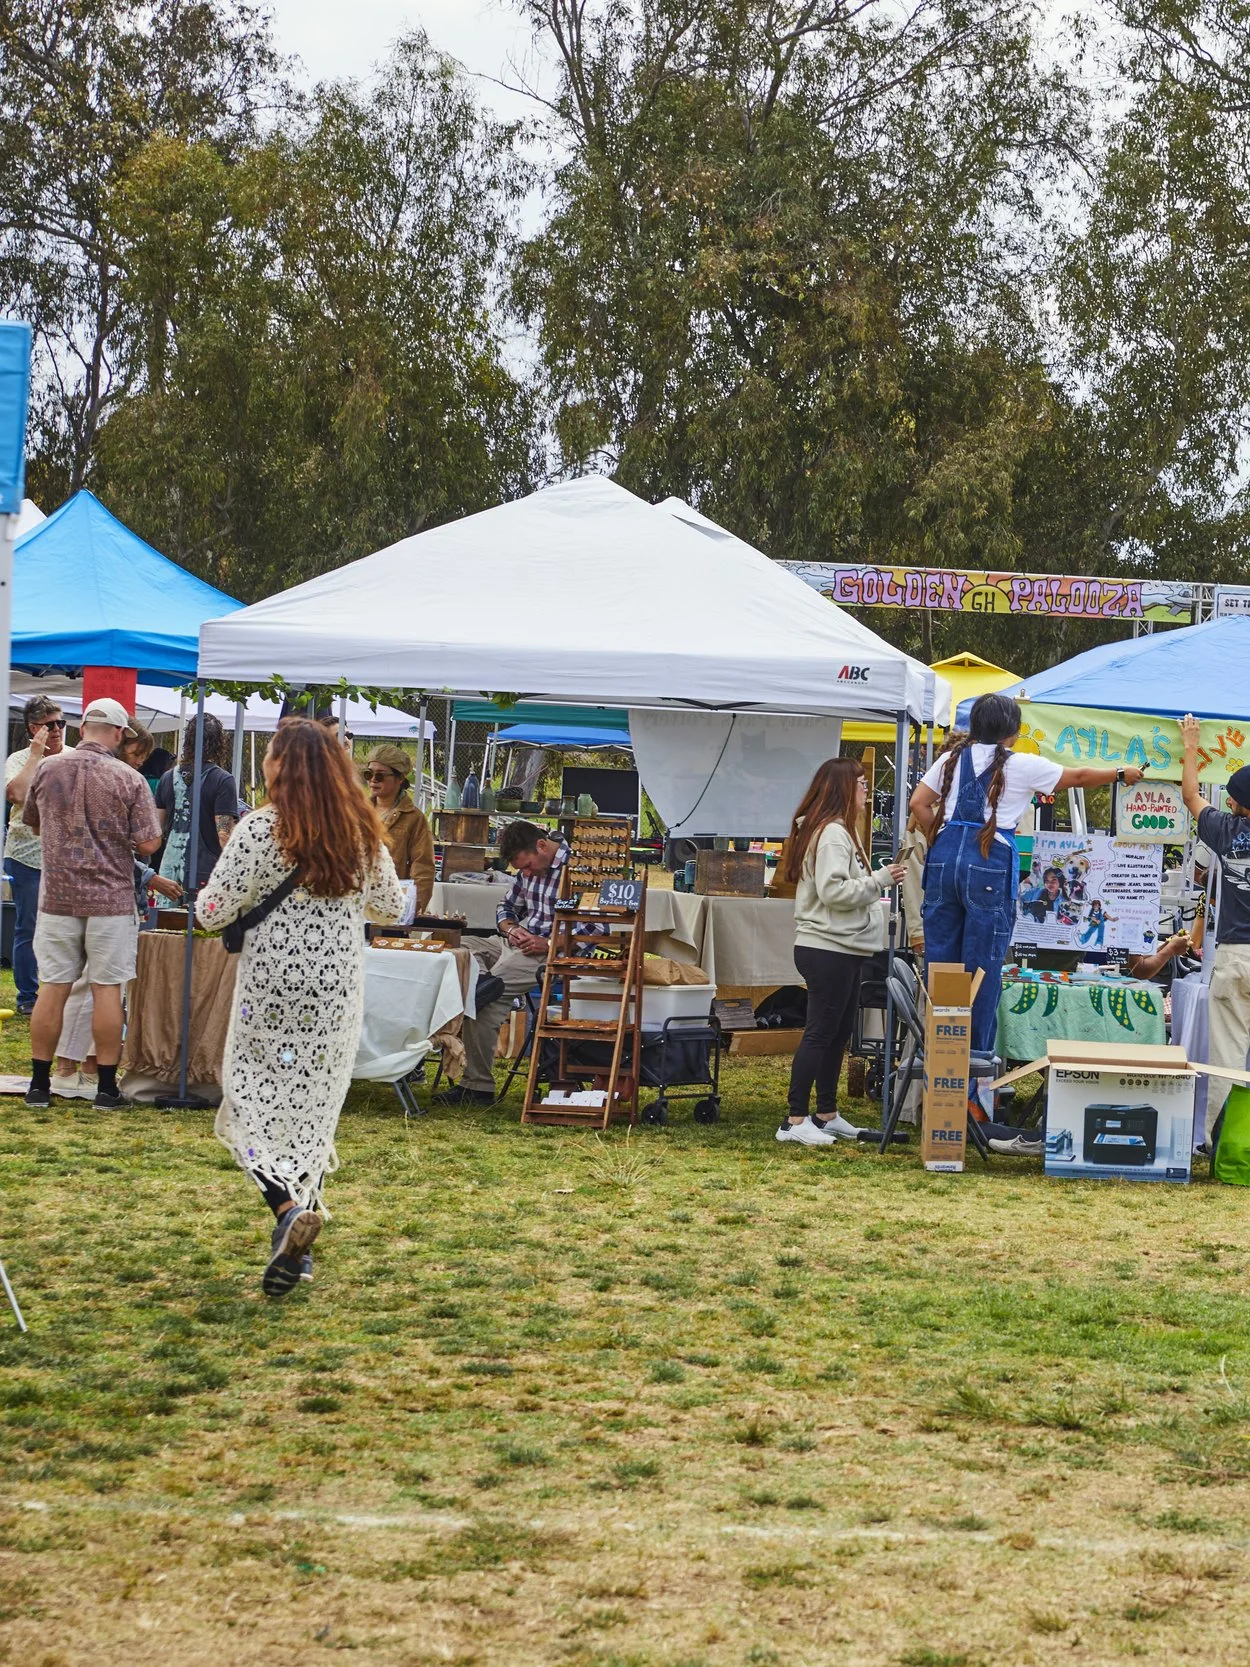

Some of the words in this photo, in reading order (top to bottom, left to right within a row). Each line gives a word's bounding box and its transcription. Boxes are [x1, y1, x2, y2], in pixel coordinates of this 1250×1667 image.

[832, 569, 967, 610] GOLDEN
[971, 591, 995, 612] GH
[1009, 577, 1144, 618] PALOOZA
[1224, 598, 1239, 608] SET
[837, 665, 870, 681] ABC
[1055, 724, 1172, 771] AYLA'S
[1179, 725, 1245, 772] IVE
[1125, 803, 1178, 814] HAND-PAINTED
[1060, 839, 1085, 850] AYLA
[608, 882, 635, 900] $10
[936, 1024, 967, 1036] FREE
[1056, 1070, 1100, 1080] EPSON
[933, 1077, 965, 1089] FREE
[931, 1129, 962, 1141] FREE
